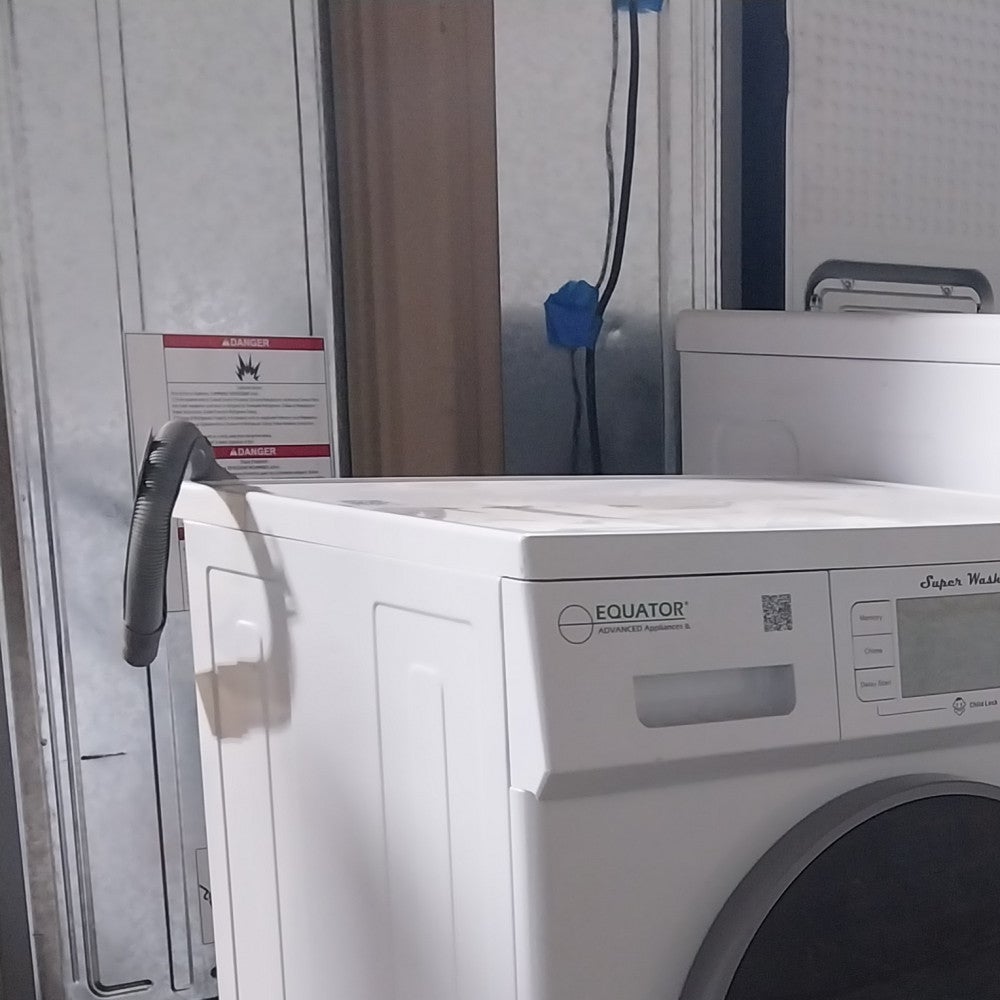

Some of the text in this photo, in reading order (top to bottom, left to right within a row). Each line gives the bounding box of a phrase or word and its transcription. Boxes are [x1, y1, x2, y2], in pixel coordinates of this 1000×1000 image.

[229, 338, 270, 347] DANGER
[237, 447, 277, 456] DANGER
[919, 574, 963, 591] Super
[595, 601, 685, 620] EQUATOR
[598, 625, 643, 635] ADVANCED
[644, 624, 684, 633] Appliances
